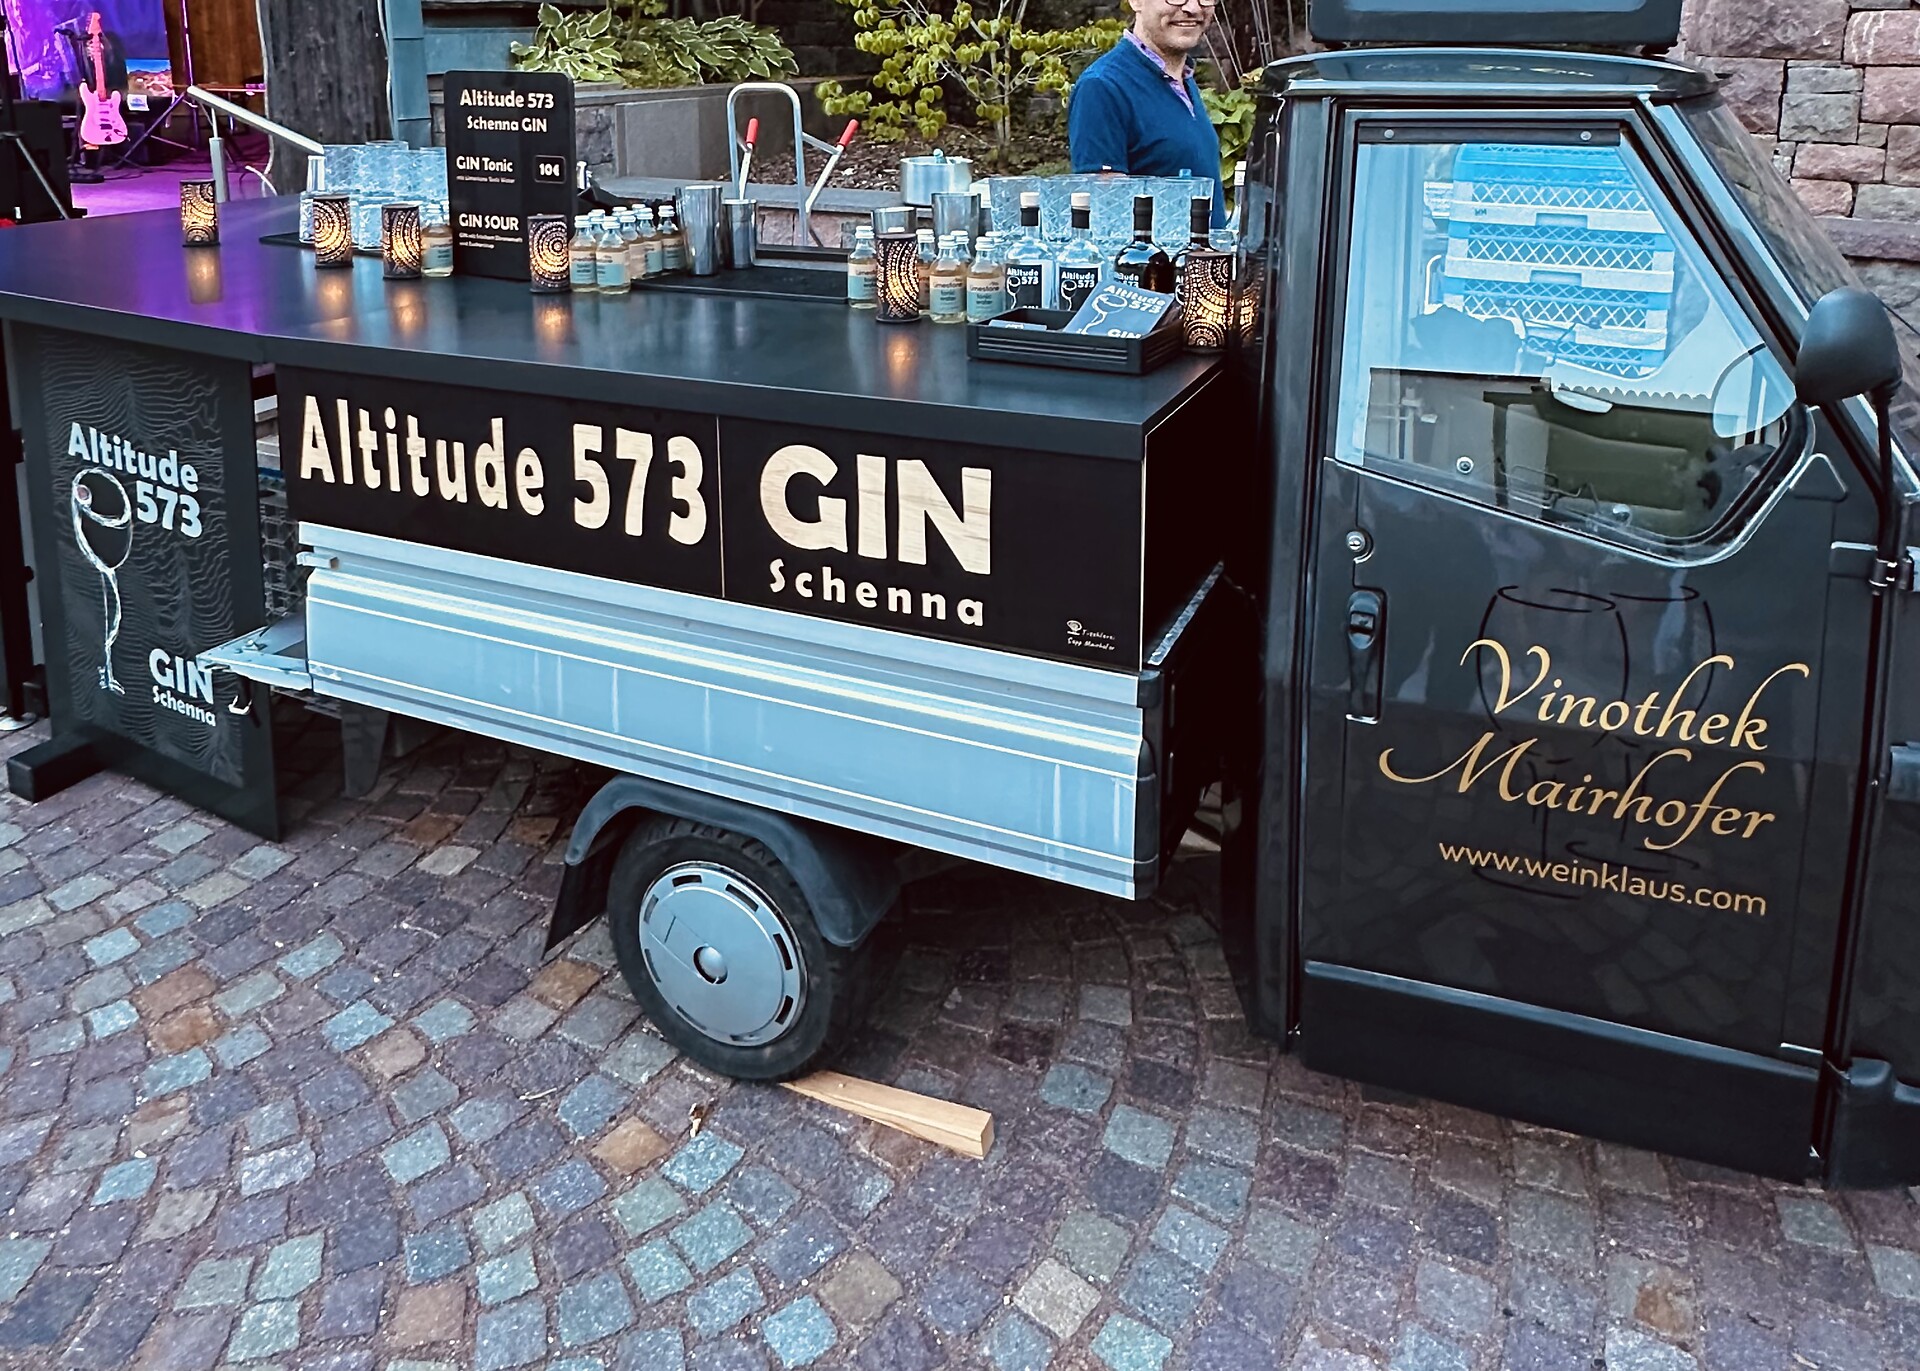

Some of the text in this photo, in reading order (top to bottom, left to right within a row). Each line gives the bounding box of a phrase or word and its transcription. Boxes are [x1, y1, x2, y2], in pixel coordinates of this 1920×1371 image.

[459, 88, 554, 109] Altitude 573
[467, 115, 547, 133] Schenna GIN
[456, 155, 514, 173] GIN Tonic
[538, 163, 560, 177] 10€
[458, 213, 520, 231] GIN SOUR
[1006, 267, 1039, 277] Altitude
[1021, 276, 1039, 285] 573
[1061, 271, 1095, 281] Altitude
[1077, 280, 1095, 289] 573
[1103, 284, 1166, 306] Altitude
[1128, 300, 1162, 314] 573
[67, 421, 199, 493] Altitude
[300, 395, 707, 545] Altitude 573
[135, 480, 203, 538] 573
[760, 444, 992, 575] GIN
[769, 558, 985, 627] Schenna
[148, 648, 214, 705] GIN
[1459, 638, 1810, 752] Vinothek
[152, 685, 217, 728] Schenna
[1378, 730, 1776, 851] Mairhofer
[1437, 841, 1767, 917] www.weinklaus.com
